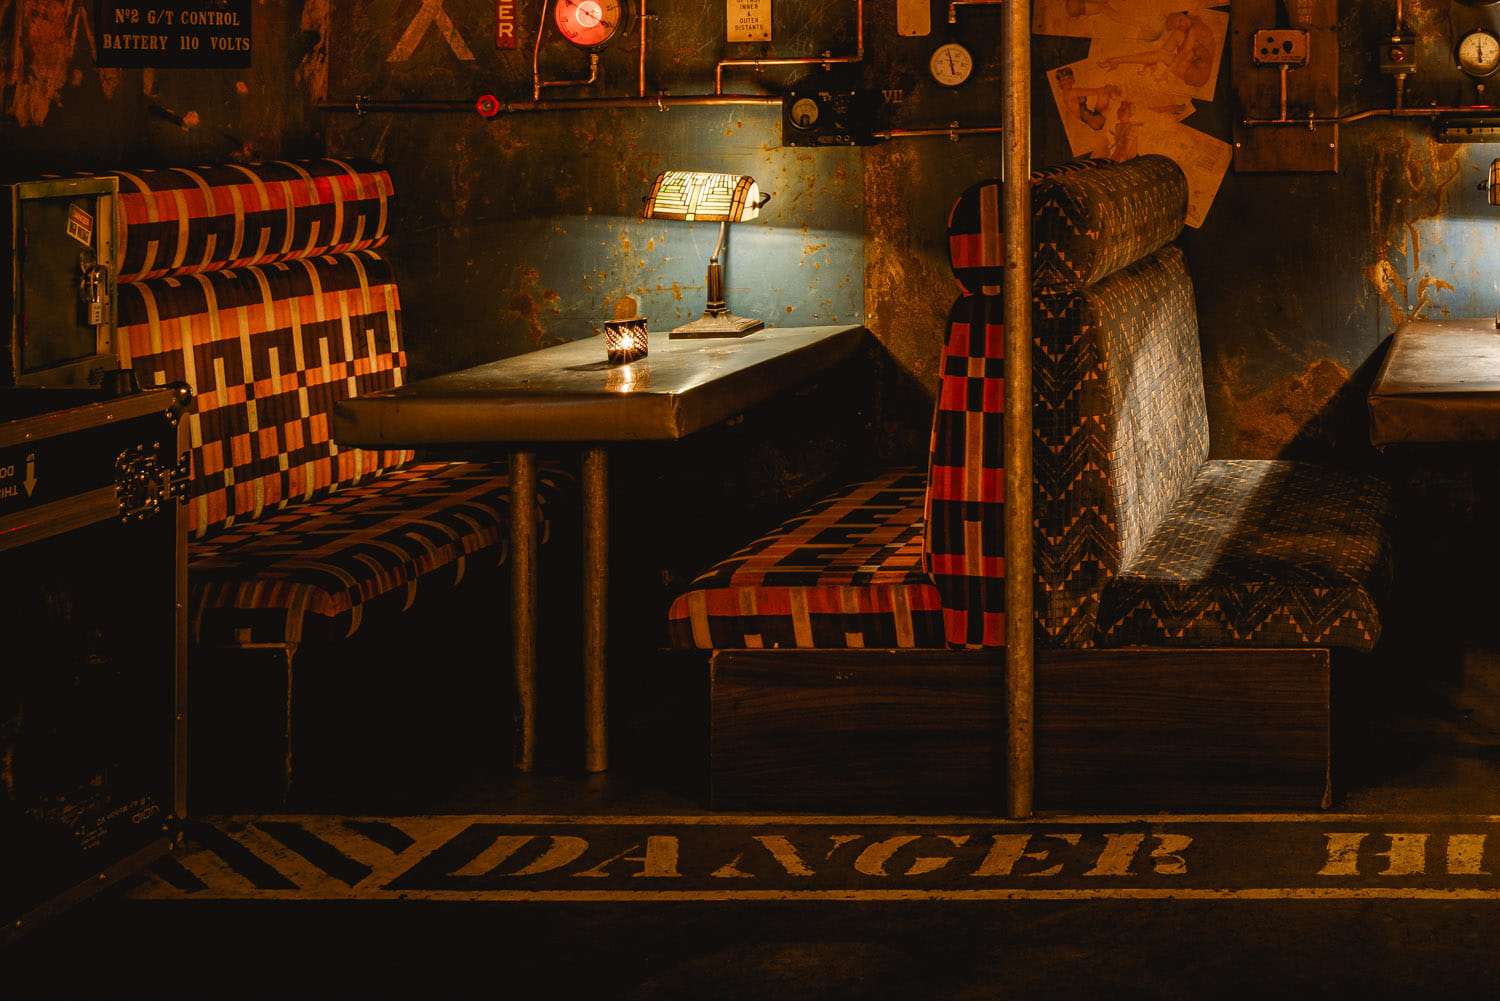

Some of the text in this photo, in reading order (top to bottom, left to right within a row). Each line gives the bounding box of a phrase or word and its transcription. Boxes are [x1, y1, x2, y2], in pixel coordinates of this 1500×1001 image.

[147, 9, 175, 25] G/T
[180, 11, 241, 27] CONTROL
[103, 34, 250, 52] BATTERY 110 VOLTS
[444, 833, 1193, 877] DANGER
